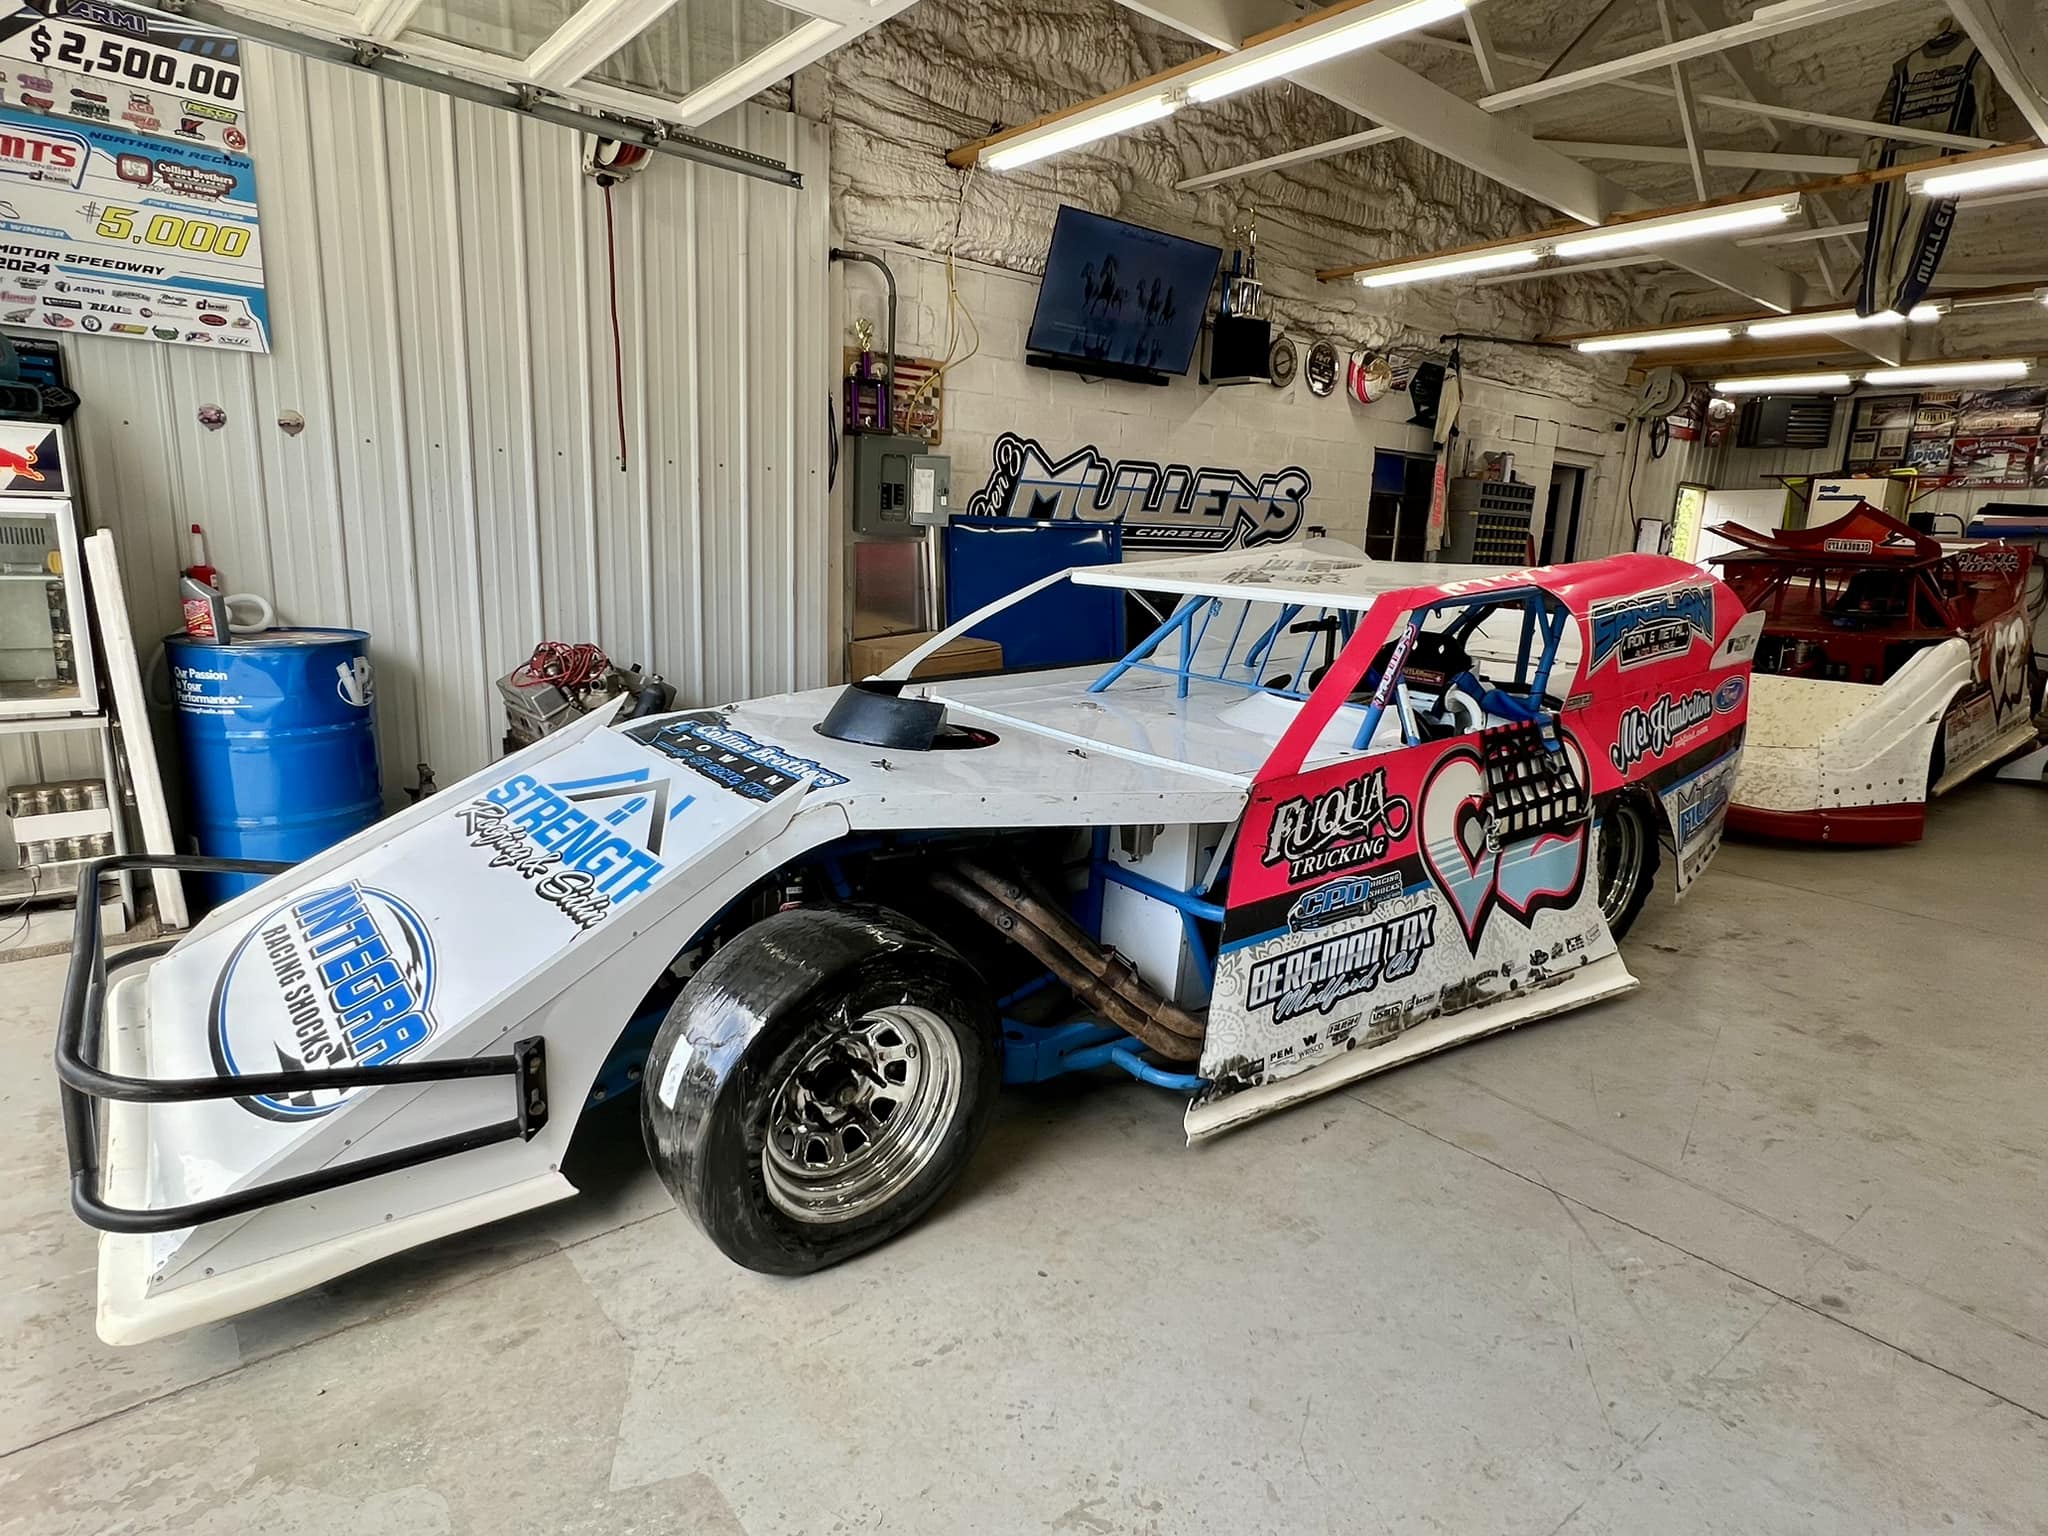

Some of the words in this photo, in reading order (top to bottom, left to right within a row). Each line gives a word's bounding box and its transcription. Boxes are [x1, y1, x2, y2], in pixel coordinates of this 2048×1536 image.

[69, 1, 146, 33] ARMI
[90, 131, 186, 156] NORTHERN
[0, 257, 50, 274] 2024
[64, 254, 165, 275] SPEEDWAY
[1008, 450, 1307, 538] MULLENS
[1136, 528, 1225, 539] CHASSIS
[174, 667, 187, 678] Our
[189, 668, 228, 681] Passion
[182, 680, 203, 693] Your
[1612, 709, 1649, 771] Mel
[1650, 693, 1711, 753] Hambelton
[696, 724, 753, 754] Collins
[757, 747, 842, 788] Brothers
[1263, 766, 1410, 864] FUQUA
[455, 801, 533, 868] Roofing
[516, 851, 563, 879] &
[1290, 836, 1386, 878] TRUCKING
[1301, 879, 1371, 917] CPD
[1369, 873, 1400, 888] RACING
[1368, 883, 1401, 898] SHOCKS
[292, 880, 436, 1067] INTEGRA
[1250, 926, 1384, 1006] BERGMAN
[1385, 909, 1434, 959] TAX
[261, 923, 305, 992] RACING
[285, 984, 334, 1065] SHOCKS
[1270, 1046, 1294, 1062] PEM
